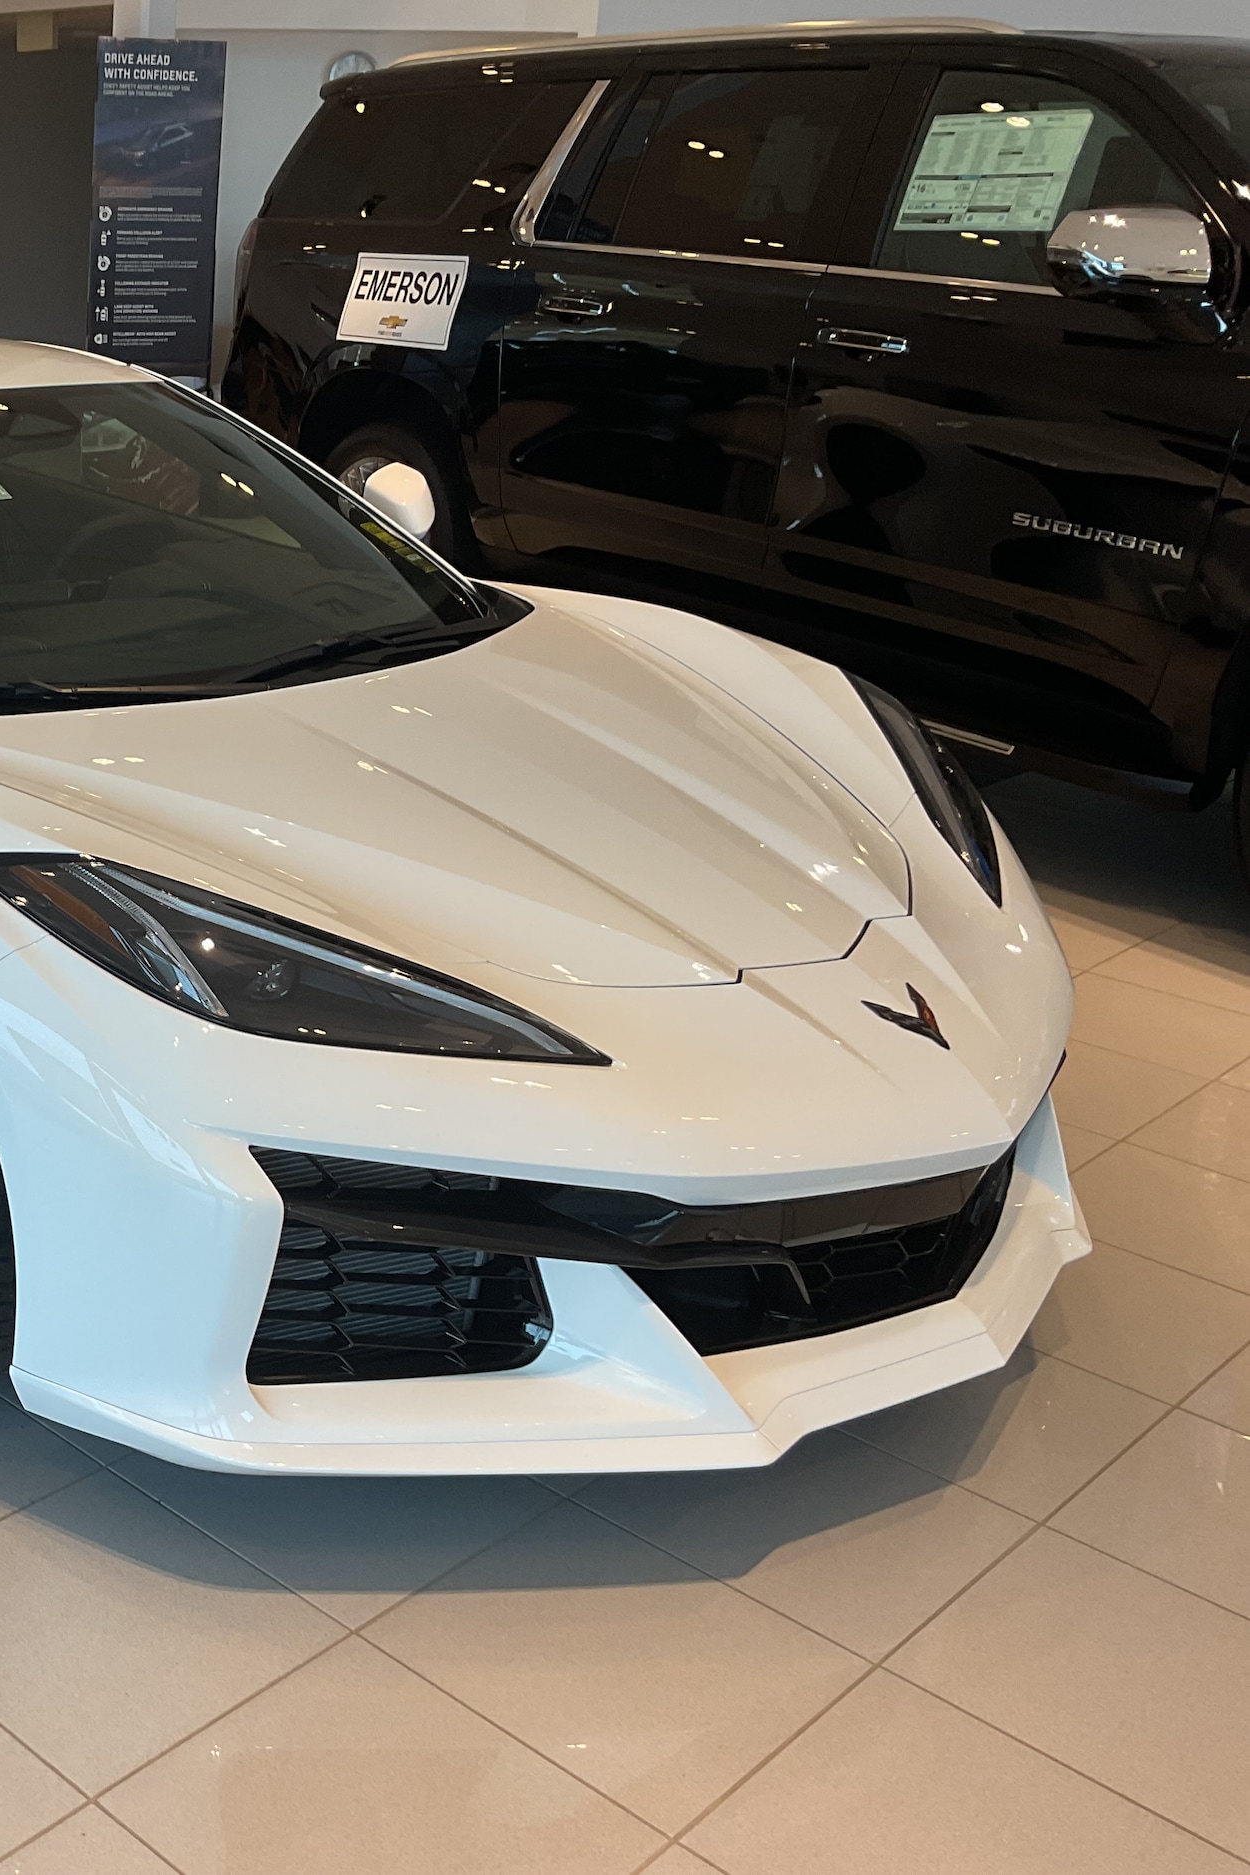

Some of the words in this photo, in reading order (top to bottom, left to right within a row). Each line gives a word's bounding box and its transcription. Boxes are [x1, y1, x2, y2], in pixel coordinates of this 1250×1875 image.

[104, 53, 134, 64] DRIVE
[136, 54, 171, 66] AHEAD
[104, 68, 131, 79] WITH
[134, 70, 198, 82] CONFIDENCE.
[354, 269, 459, 306] EMERSON
[1012, 512, 1184, 560] SUBURBAN
